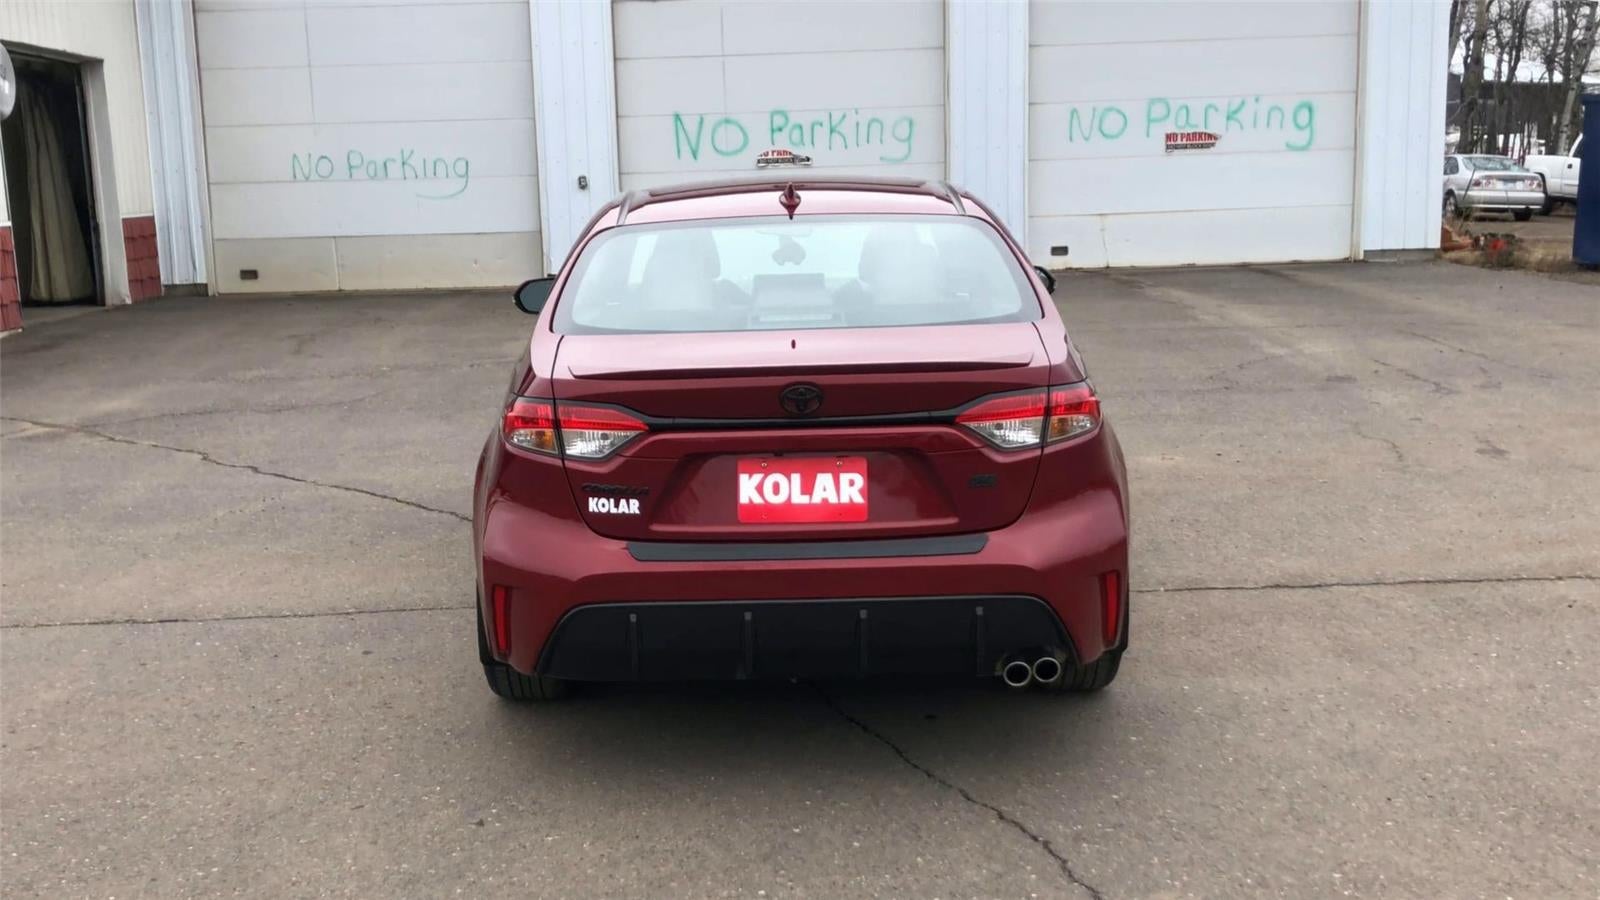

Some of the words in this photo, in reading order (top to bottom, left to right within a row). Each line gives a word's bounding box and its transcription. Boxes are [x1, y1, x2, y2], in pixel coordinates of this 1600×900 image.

[1166, 132, 1178, 142] NO
[738, 472, 865, 504] KOLAR
[588, 497, 640, 514] KOLAR
